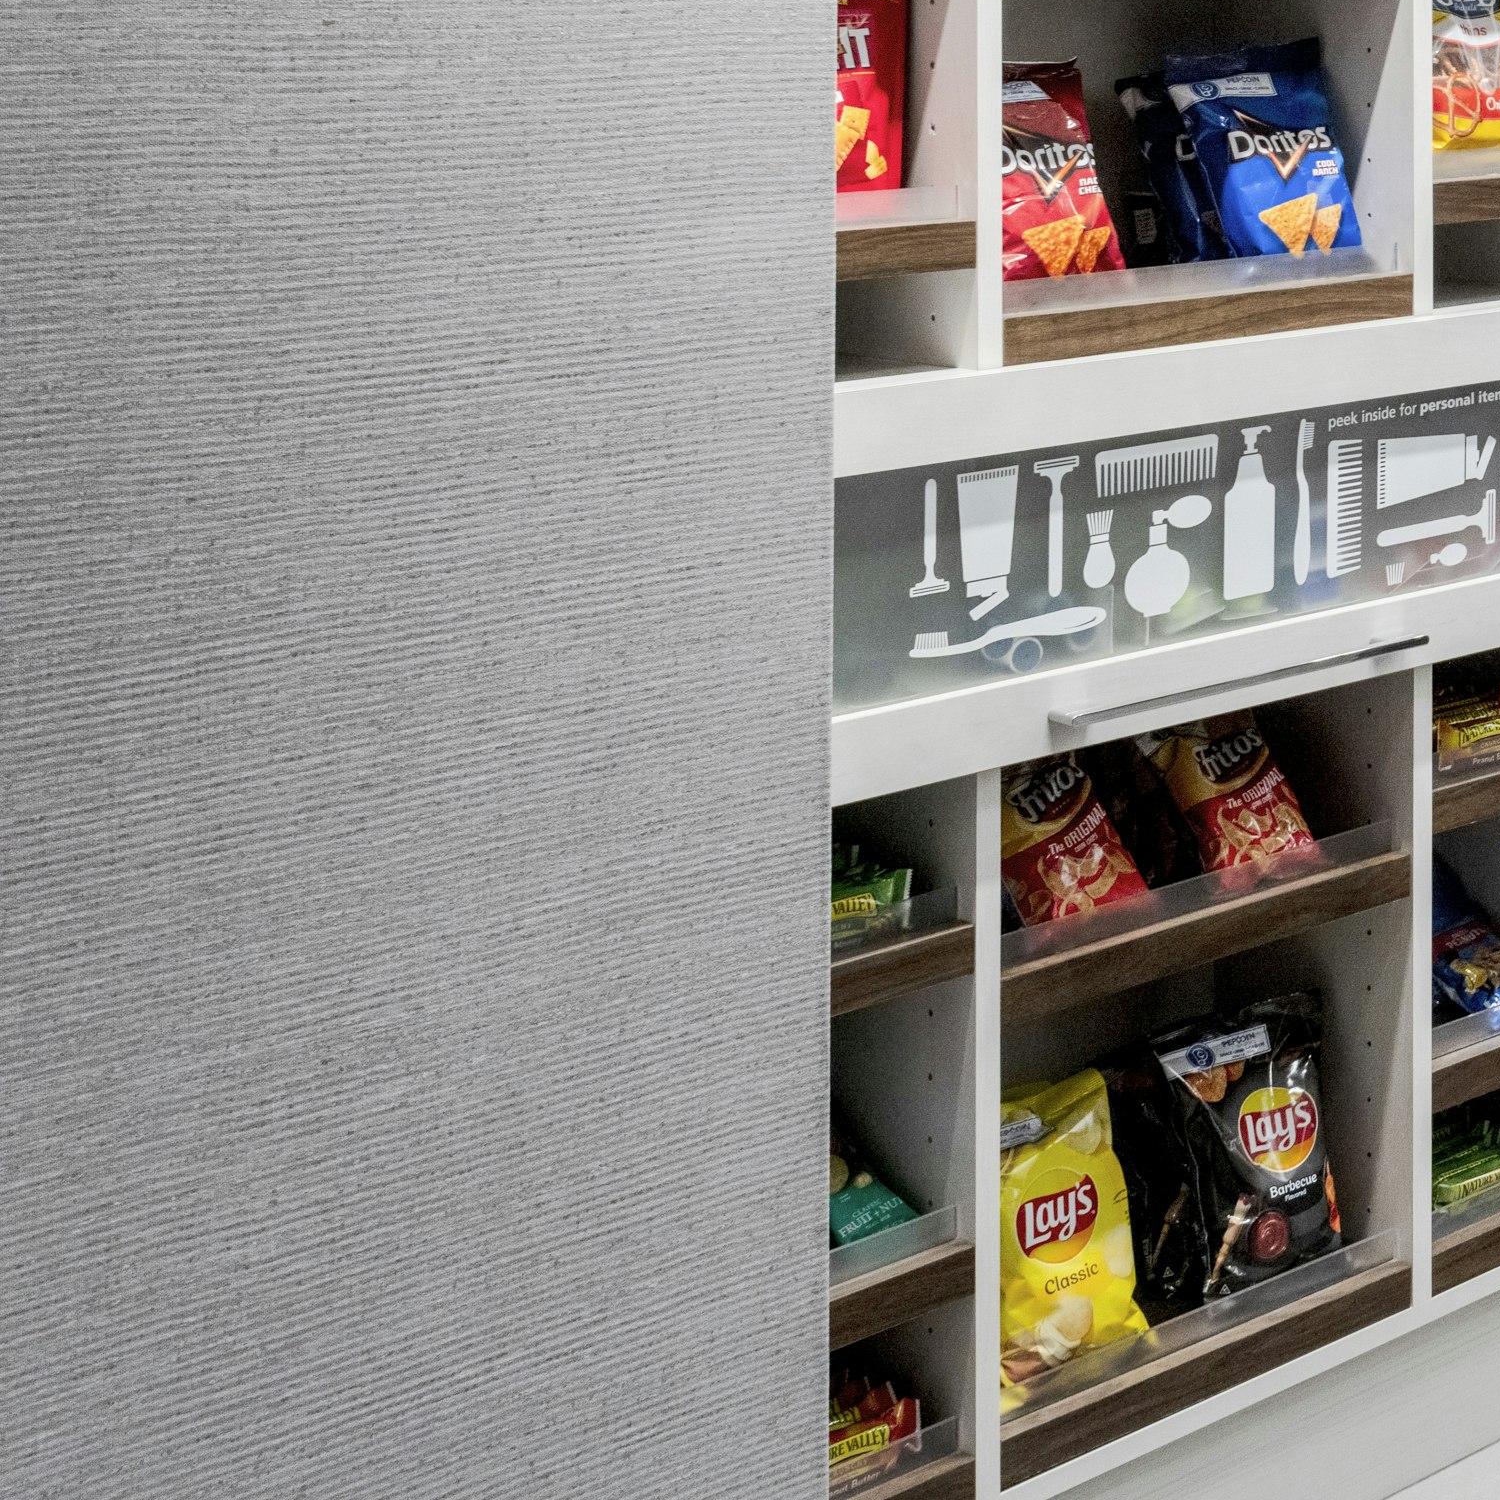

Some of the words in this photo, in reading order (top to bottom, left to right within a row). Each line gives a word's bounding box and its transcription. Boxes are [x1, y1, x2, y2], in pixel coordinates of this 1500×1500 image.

[1460, 24, 1487, 37] thins
[1227, 126, 1332, 160] Doritos
[1316, 160, 1336, 168] COOL
[1328, 412, 1358, 432] peek
[1361, 406, 1396, 423] inside
[1399, 402, 1416, 416] for
[1420, 392, 1475, 416] personal
[1462, 723, 1495, 745] NATURE
[1192, 728, 1266, 783] Fritos
[1008, 751, 1086, 823] Fritos
[1226, 797, 1242, 810] The
[1242, 767, 1286, 803] ORIGINAL
[1049, 841, 1065, 855] The
[1064, 802, 1107, 850] ORIGINAL
[1244, 1098, 1314, 1158] Lay's
[1269, 1172, 1319, 1200] Barbecue
[1284, 1189, 1308, 1202] Flavored
[838, 1211, 873, 1238] FRUIT
[1024, 1181, 1094, 1250] Lay's
[1044, 1263, 1100, 1296] Classic
[846, 1428, 888, 1452] VALLEY
